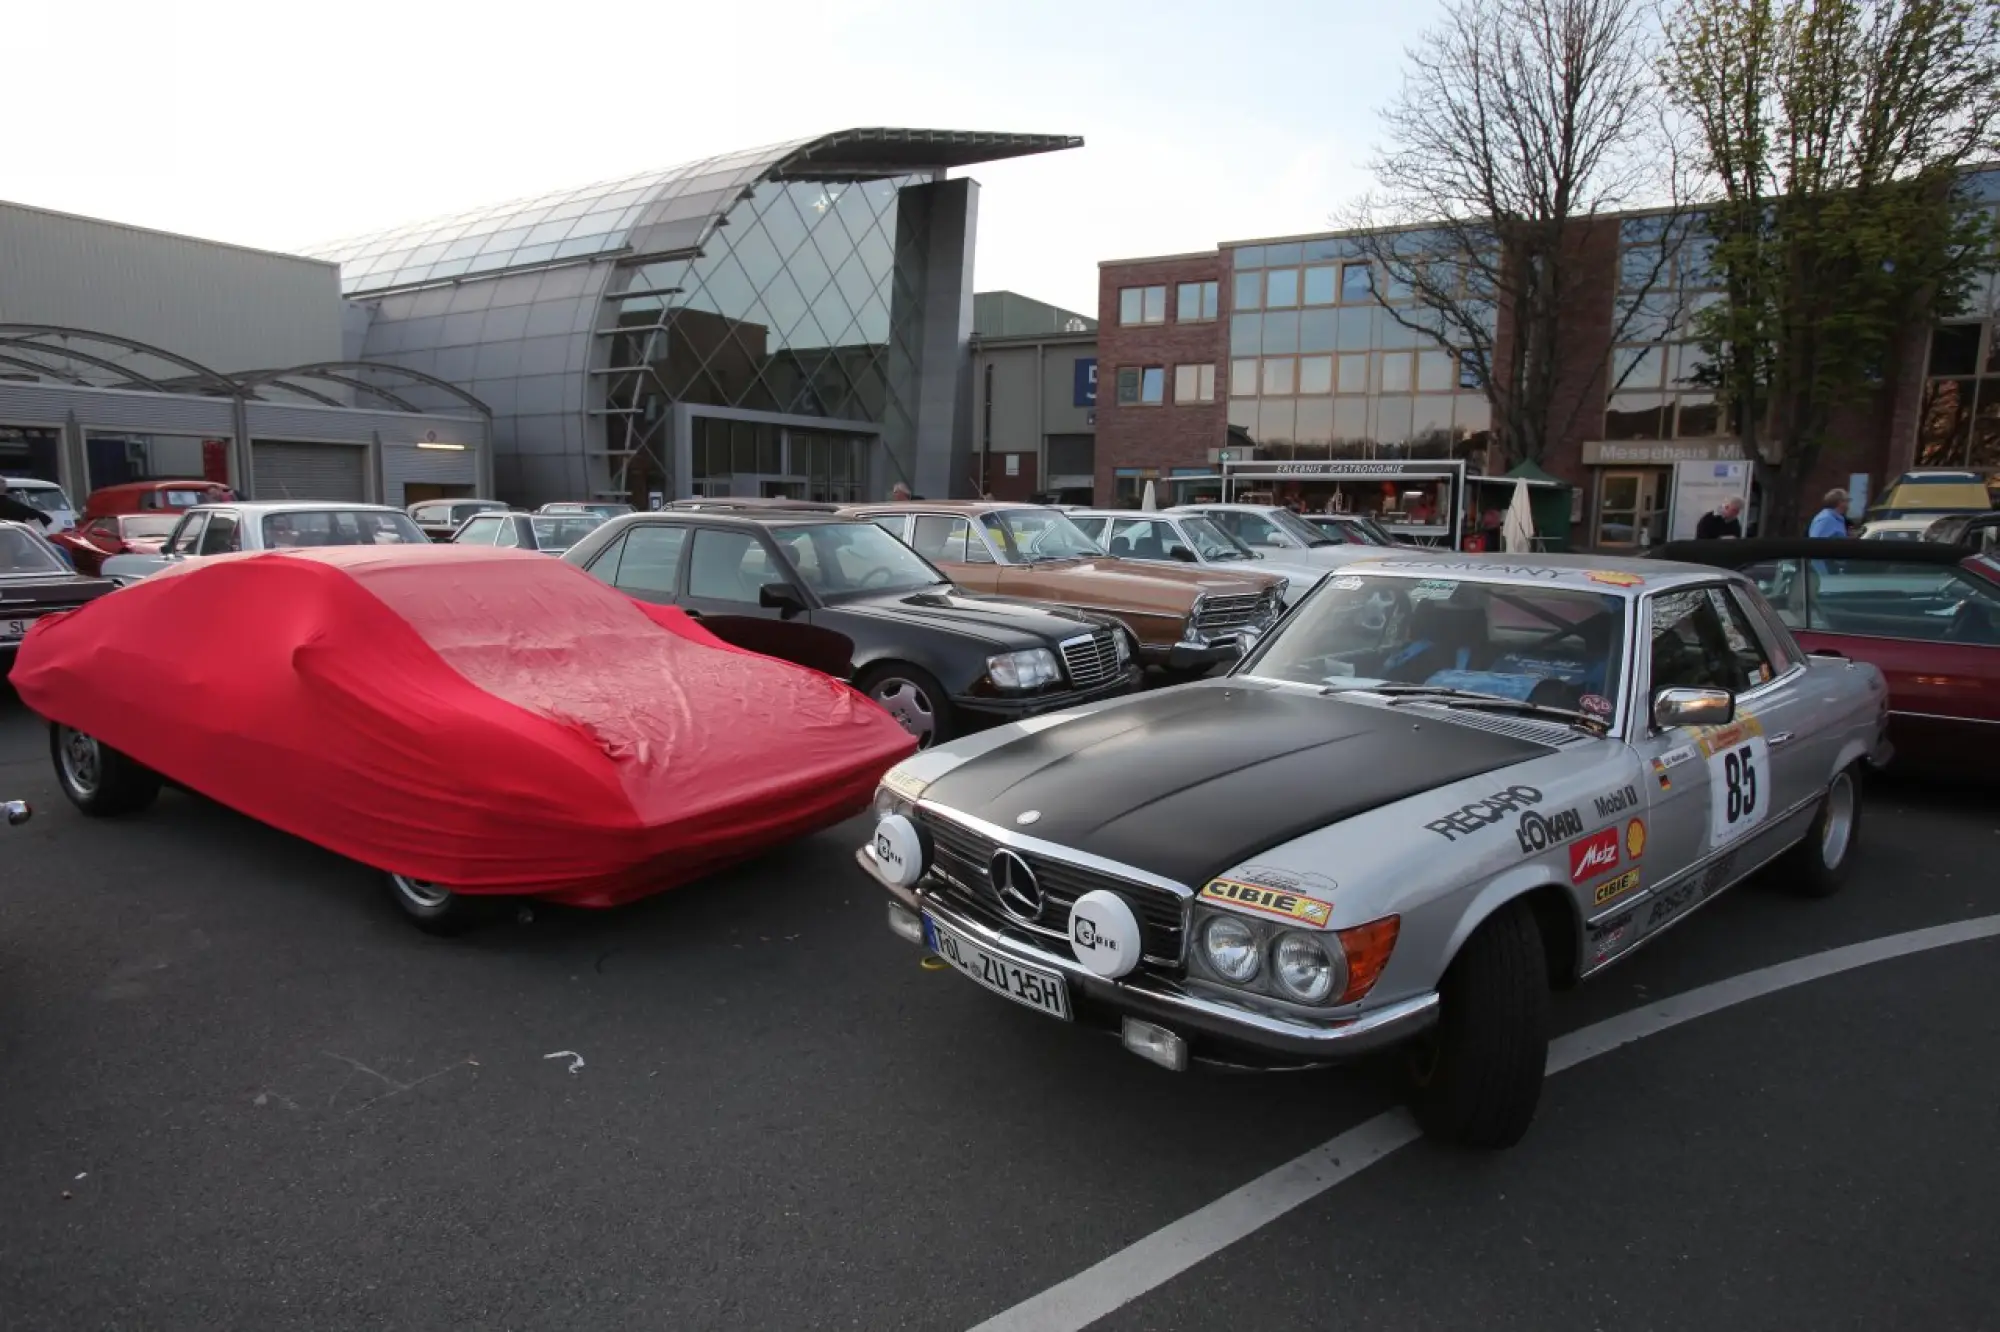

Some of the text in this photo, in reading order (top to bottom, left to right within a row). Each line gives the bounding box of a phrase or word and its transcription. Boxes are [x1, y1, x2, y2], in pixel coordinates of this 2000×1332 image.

[1276, 464, 1404, 473] ERLEBNIS GASTRONOMIE
[1600, 445, 1709, 460] Messehaus
[1724, 745, 1757, 824] 85
[1423, 785, 1543, 842] RECARO
[1594, 789, 1627, 819] Mobil
[1516, 808, 1584, 853] LOKARI
[1573, 842, 1617, 877] Metz
[1208, 881, 1298, 912] CIBIE
[1596, 875, 1629, 901] CIBIE
[979, 951, 1010, 991] ZU
[1012, 969, 1060, 1013] 15H
